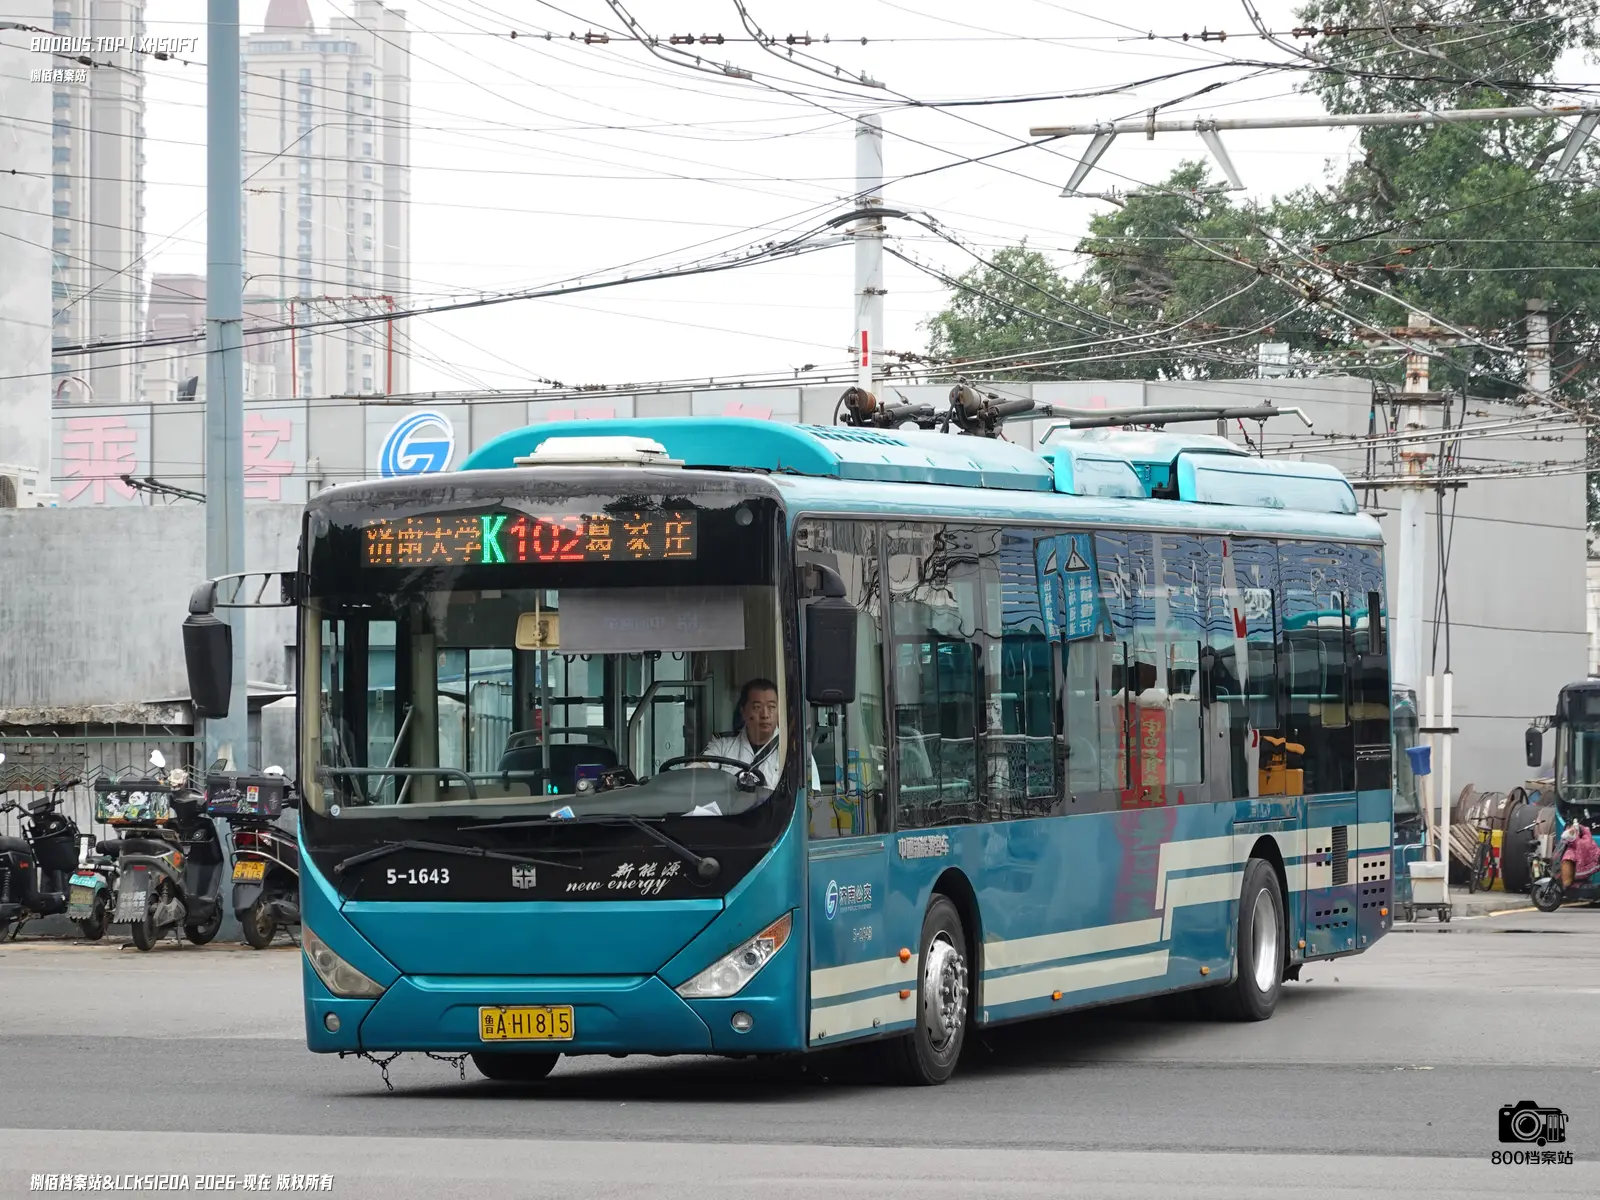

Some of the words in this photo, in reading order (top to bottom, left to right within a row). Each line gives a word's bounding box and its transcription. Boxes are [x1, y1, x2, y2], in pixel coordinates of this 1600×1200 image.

[481, 514, 584, 564] K102
[386, 867, 450, 885] 5-1643
[611, 861, 682, 879] 新能源
[566, 880, 604, 892] new
[607, 877, 671, 895] energy
